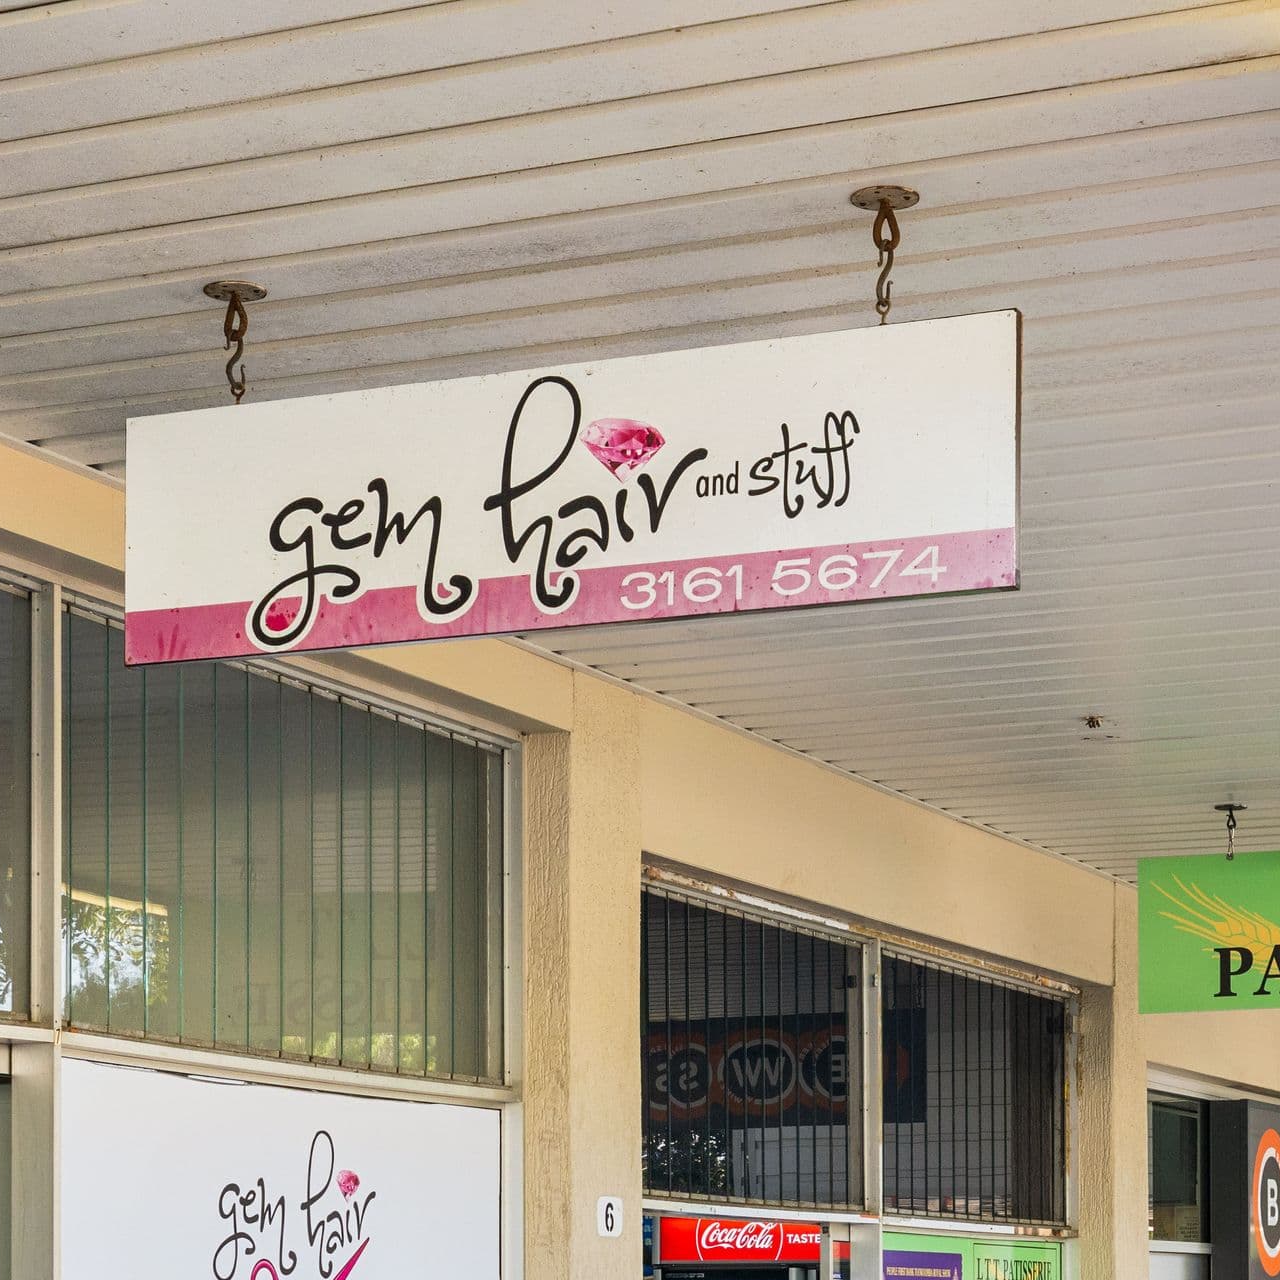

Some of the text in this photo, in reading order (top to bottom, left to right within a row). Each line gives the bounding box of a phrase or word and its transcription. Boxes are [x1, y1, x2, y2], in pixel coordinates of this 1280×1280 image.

[251, 375, 861, 647] gem hair and stuff
[620, 545, 948, 611] 3161 5674
[300, 1130, 377, 1279] hair
[604, 1203, 615, 1232] 6
[701, 1221, 821, 1250] Coca-Cola TASTE
